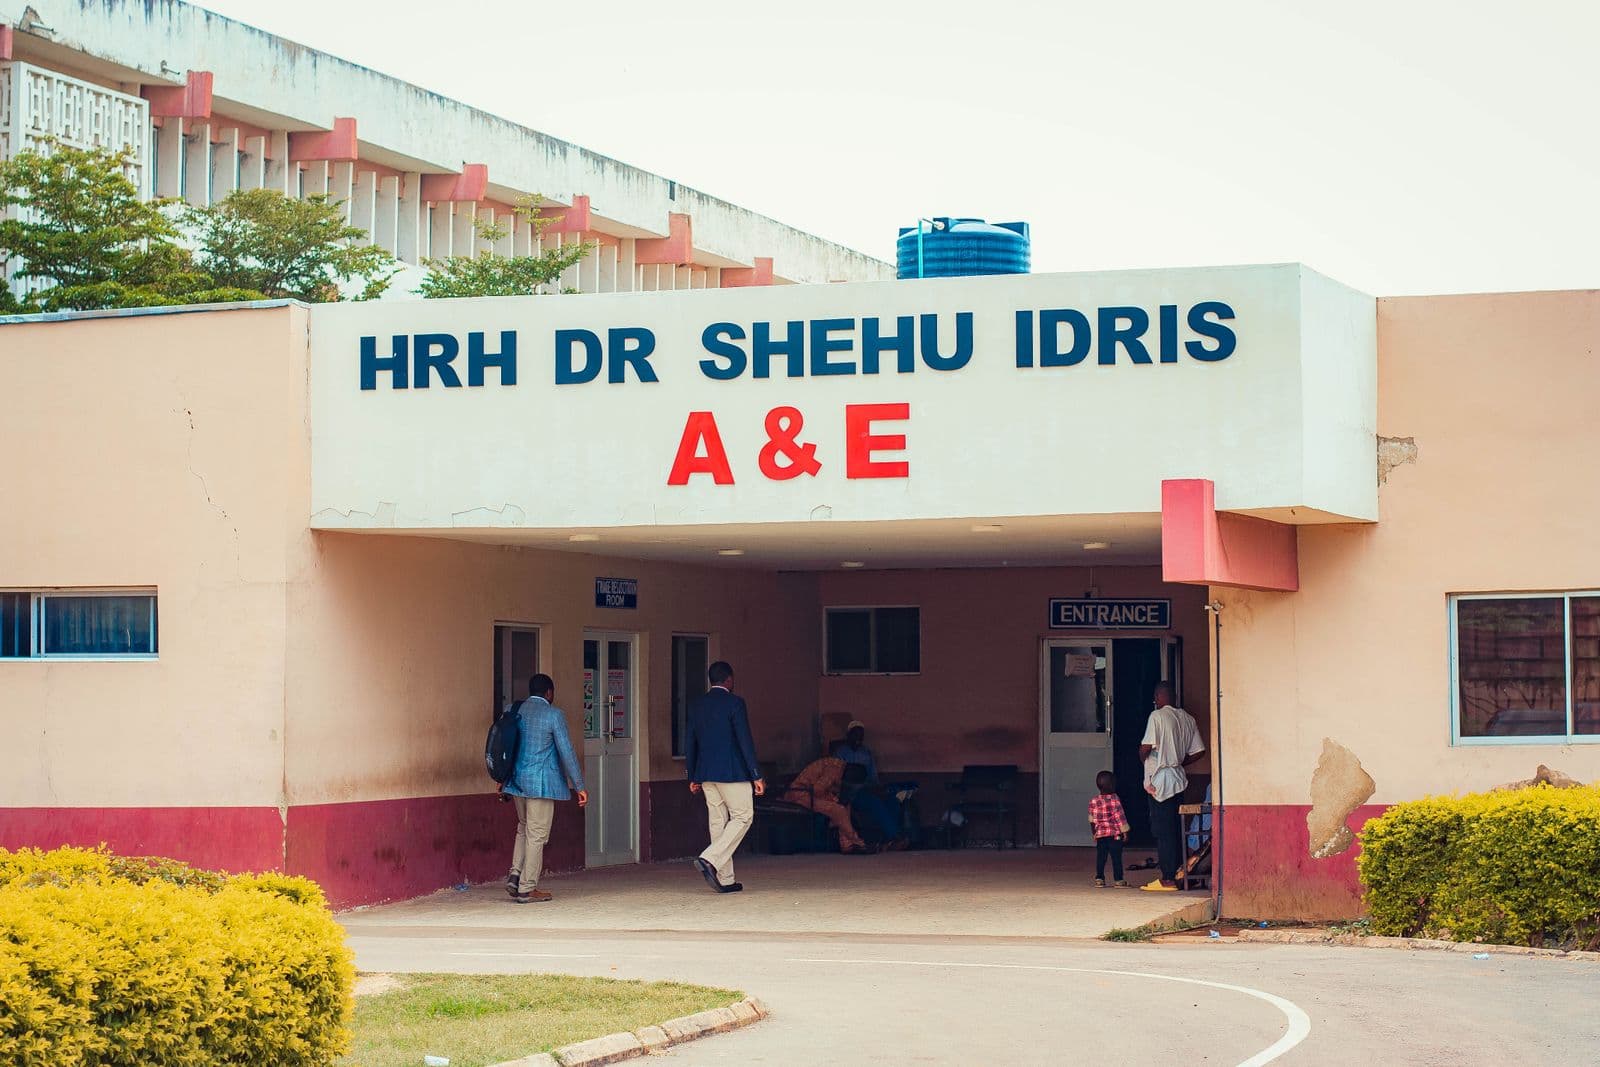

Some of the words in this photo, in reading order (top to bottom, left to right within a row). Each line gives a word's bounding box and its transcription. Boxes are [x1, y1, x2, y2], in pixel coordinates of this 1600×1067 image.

[360, 331, 517, 390] HRH
[555, 328, 660, 385] DR
[699, 312, 974, 380] SHEHU
[1015, 302, 1237, 368] IDRIS
[667, 411, 735, 486] A
[758, 405, 822, 481] &
[846, 403, 911, 479] E
[606, 594, 625, 606] ROOM
[1060, 604, 1159, 623] ENTRANCE
